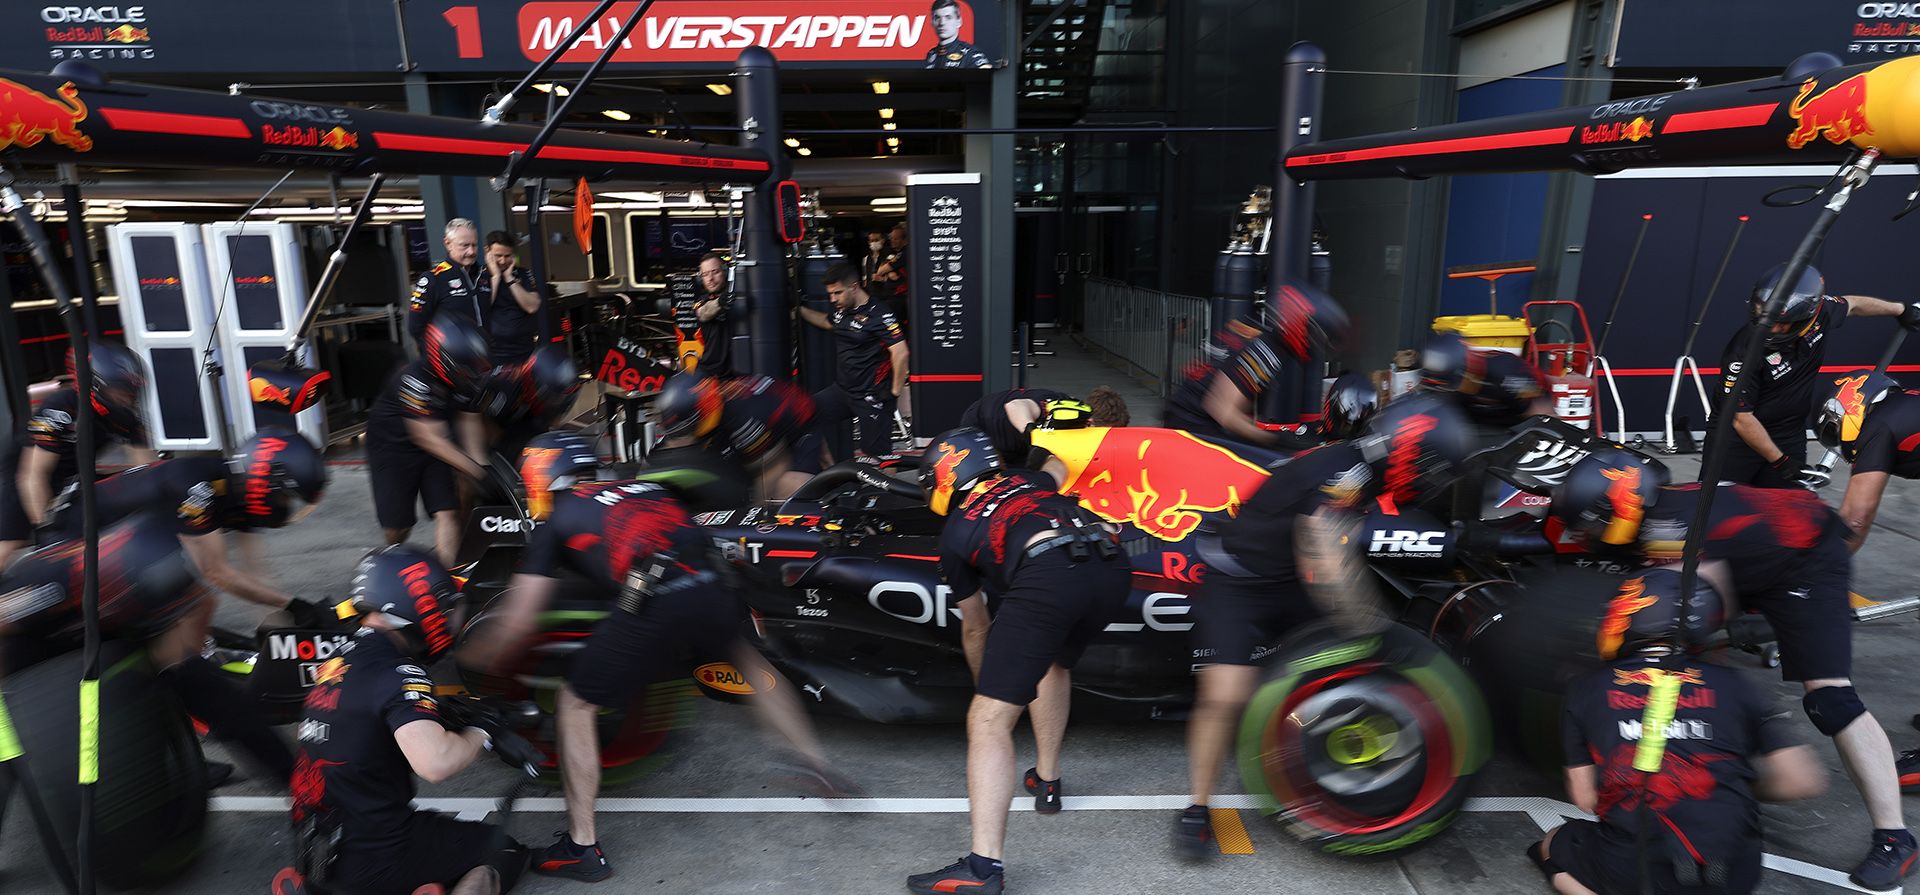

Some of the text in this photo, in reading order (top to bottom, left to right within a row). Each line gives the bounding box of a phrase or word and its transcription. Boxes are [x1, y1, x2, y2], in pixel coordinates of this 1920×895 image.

[41, 6, 146, 23] ORACLE
[442, 6, 484, 58] 1
[528, 15, 927, 50] MAX VERSTAPPEN
[49, 48, 155, 59] RACING
[1848, 43, 1920, 53] RACI
[250, 100, 354, 125] ORACLE
[1590, 95, 1673, 120] ORACLE
[598, 348, 667, 392] Red
[480, 516, 535, 533] Claro
[1368, 530, 1446, 552] HRC
[796, 606, 829, 617] Tezos
[269, 634, 350, 660] Mob
